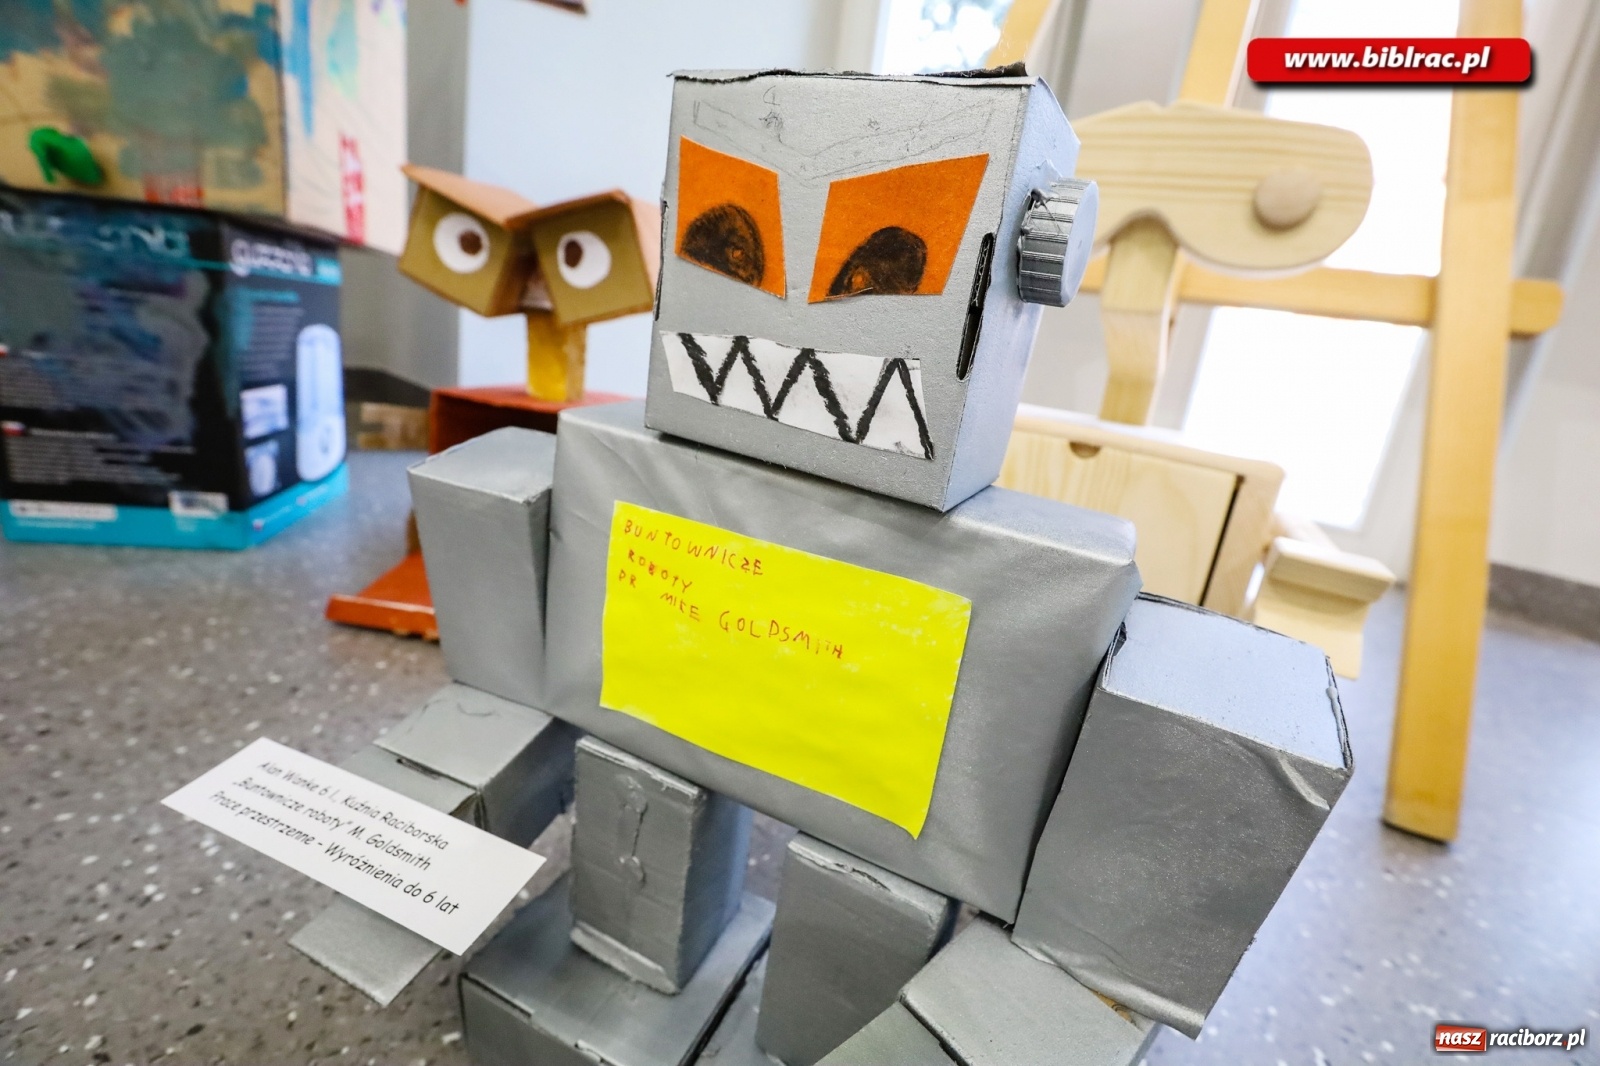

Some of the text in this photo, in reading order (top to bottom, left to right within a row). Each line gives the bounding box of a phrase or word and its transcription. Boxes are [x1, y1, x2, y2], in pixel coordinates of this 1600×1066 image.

[628, 549, 692, 593] ROBOTY
[719, 610, 843, 659] GOLDSMITH
[258, 762, 283, 776] Alan
[318, 785, 331, 796] 6
[342, 795, 381, 819] Kuźnia
[381, 811, 449, 850] Raciborska
[209, 790, 242, 812] Prace
[235, 806, 316, 846] przestrzenne
[324, 842, 404, 889] Wyróżnienia
[403, 882, 422, 898] do
[423, 891, 438, 904] 6
[435, 895, 460, 915] lat
[347, 825, 362, 840] M.
[366, 833, 431, 871] Goldsmith
